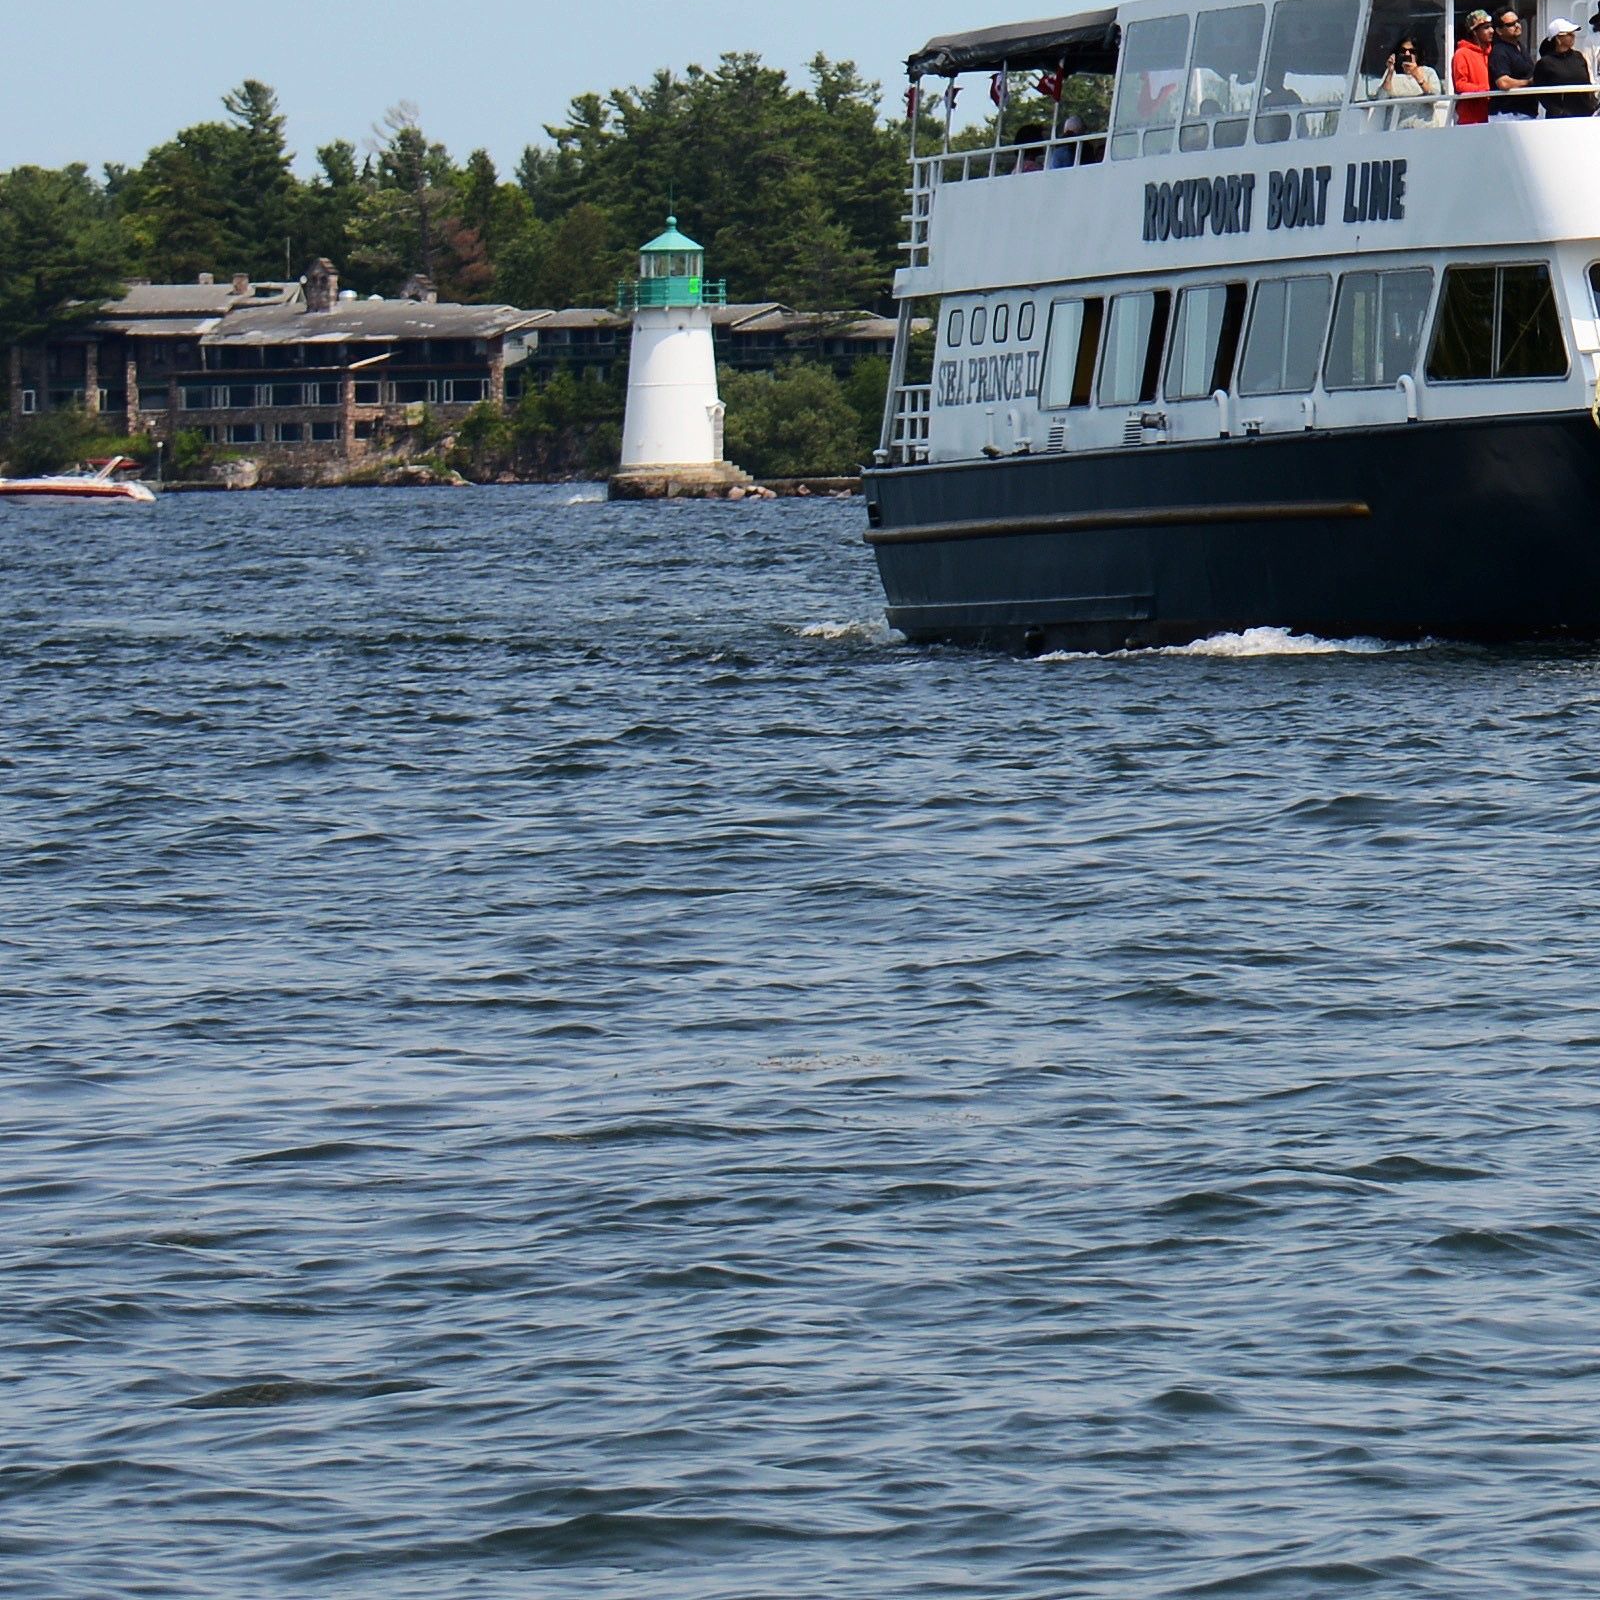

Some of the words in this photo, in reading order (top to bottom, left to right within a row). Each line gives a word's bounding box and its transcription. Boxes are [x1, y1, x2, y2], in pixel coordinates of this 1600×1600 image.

[1142, 173, 1256, 241] ROCKPORT
[1267, 165, 1332, 230] BOAT
[1343, 158, 1408, 223] LINE
[936, 360, 965, 407] SEA
[966, 352, 1024, 404] PRINCE
[1025, 350, 1040, 398] II
